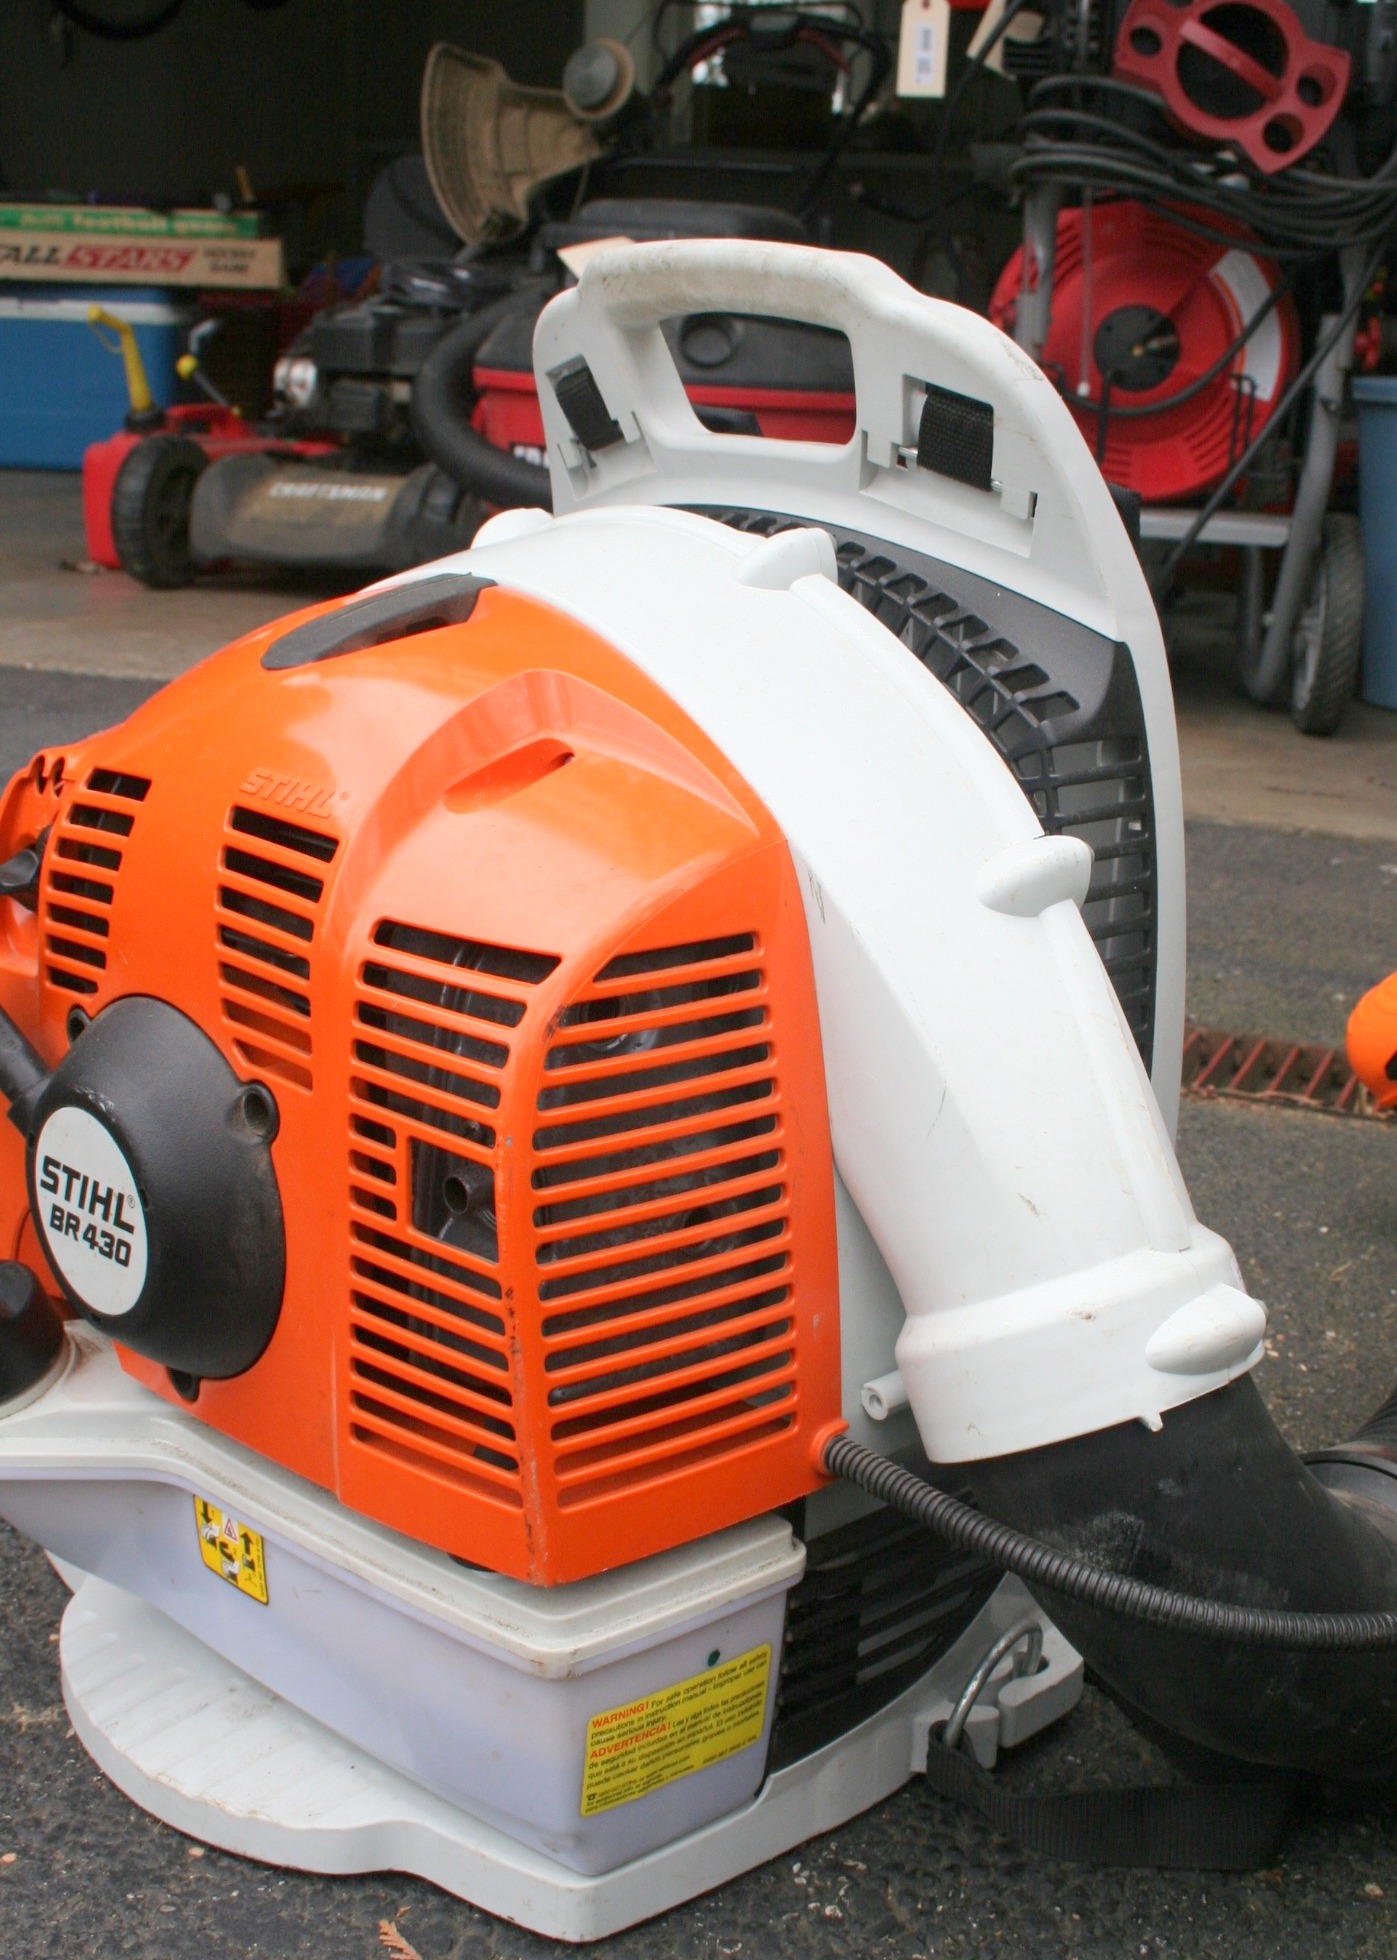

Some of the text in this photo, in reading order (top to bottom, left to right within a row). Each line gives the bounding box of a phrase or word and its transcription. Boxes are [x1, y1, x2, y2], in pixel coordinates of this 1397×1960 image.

[239, 768, 335, 820] STIHL
[592, 1701, 649, 1729] WARNING!
[683, 1676, 715, 1694] operation
[591, 1720, 634, 1740] precautions
[591, 1735, 614, 1748] cause
[617, 1723, 644, 1739] serious
